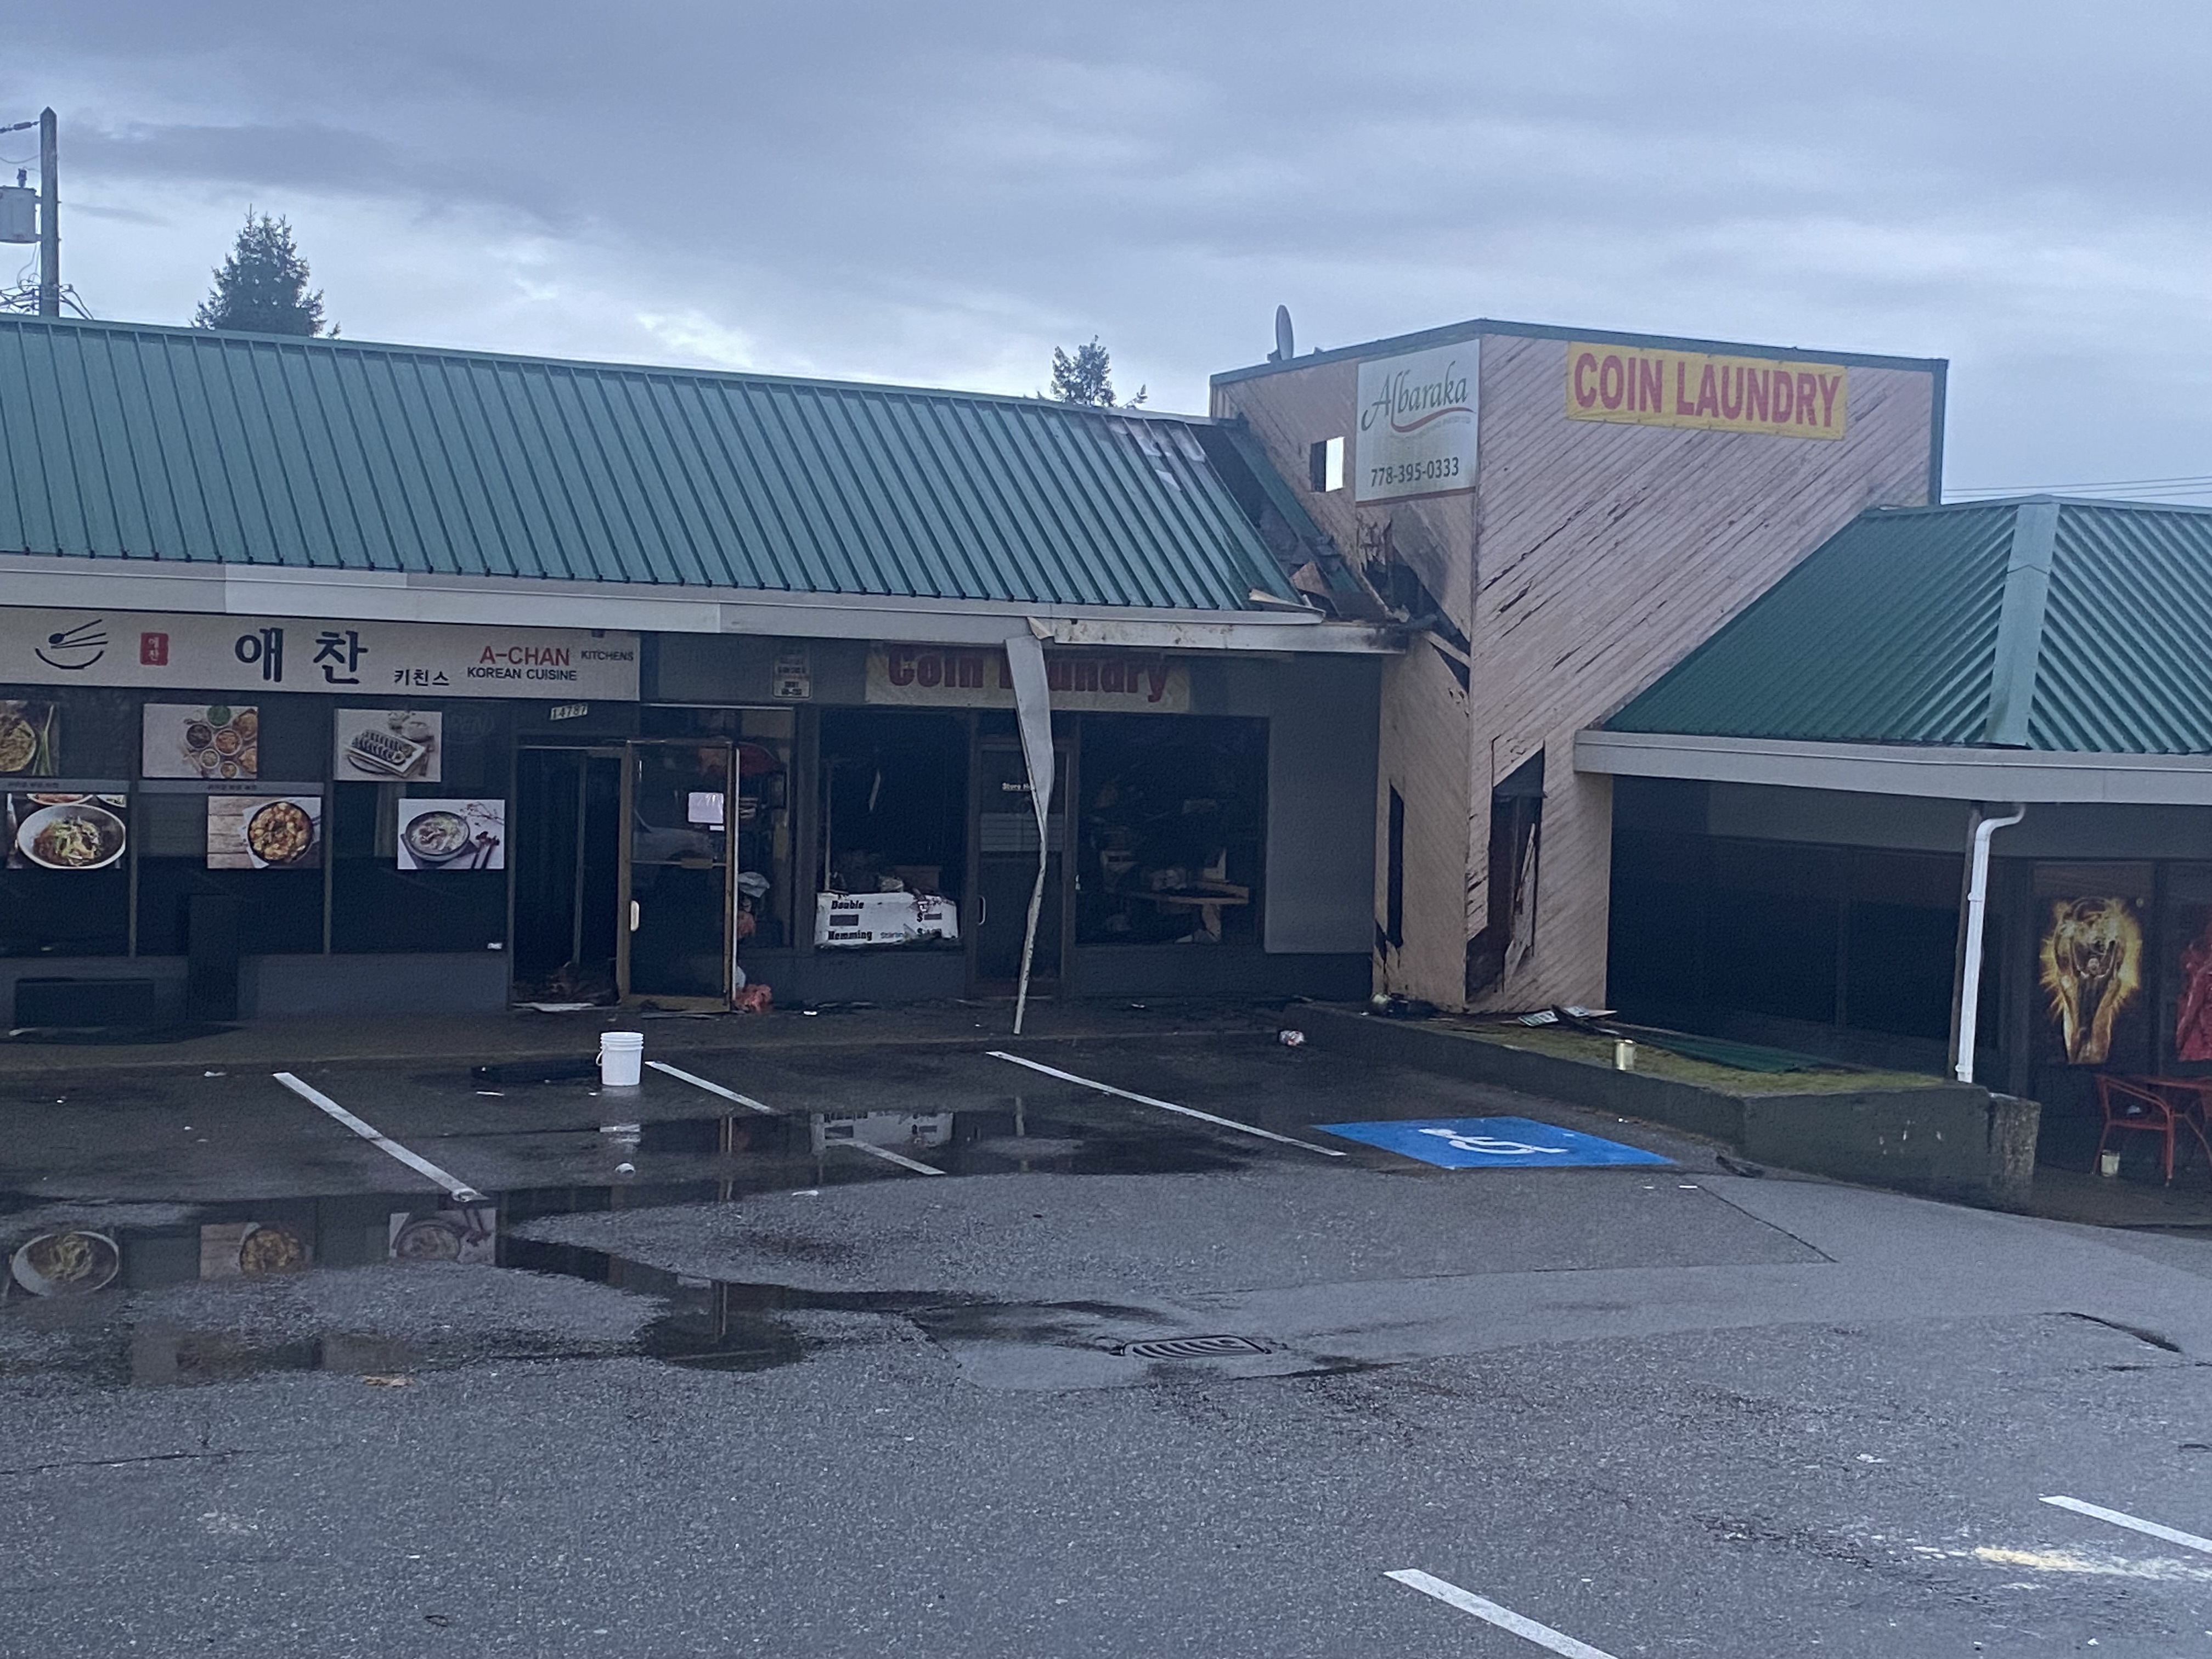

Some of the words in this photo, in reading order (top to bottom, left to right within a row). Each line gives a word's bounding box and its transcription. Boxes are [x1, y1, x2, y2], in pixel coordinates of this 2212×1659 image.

[1361, 360, 1469, 431] Albaraka
[1574, 352, 1663, 414] COIN
[1675, 361, 1843, 428] LAUNDRY
[1371, 456, 1459, 487] 778-395-0333
[479, 645, 570, 667] A-CHAN
[580, 650, 634, 662] KITCHENS
[394, 669, 450, 687] 키친스
[467, 667, 522, 679] KOREAN
[526, 669, 577, 681] CUISINE
[888, 645, 984, 689] Coin
[998, 648, 1169, 703] Lundry
[831, 900, 865, 910] Double
[827, 929, 873, 941] Hemming
